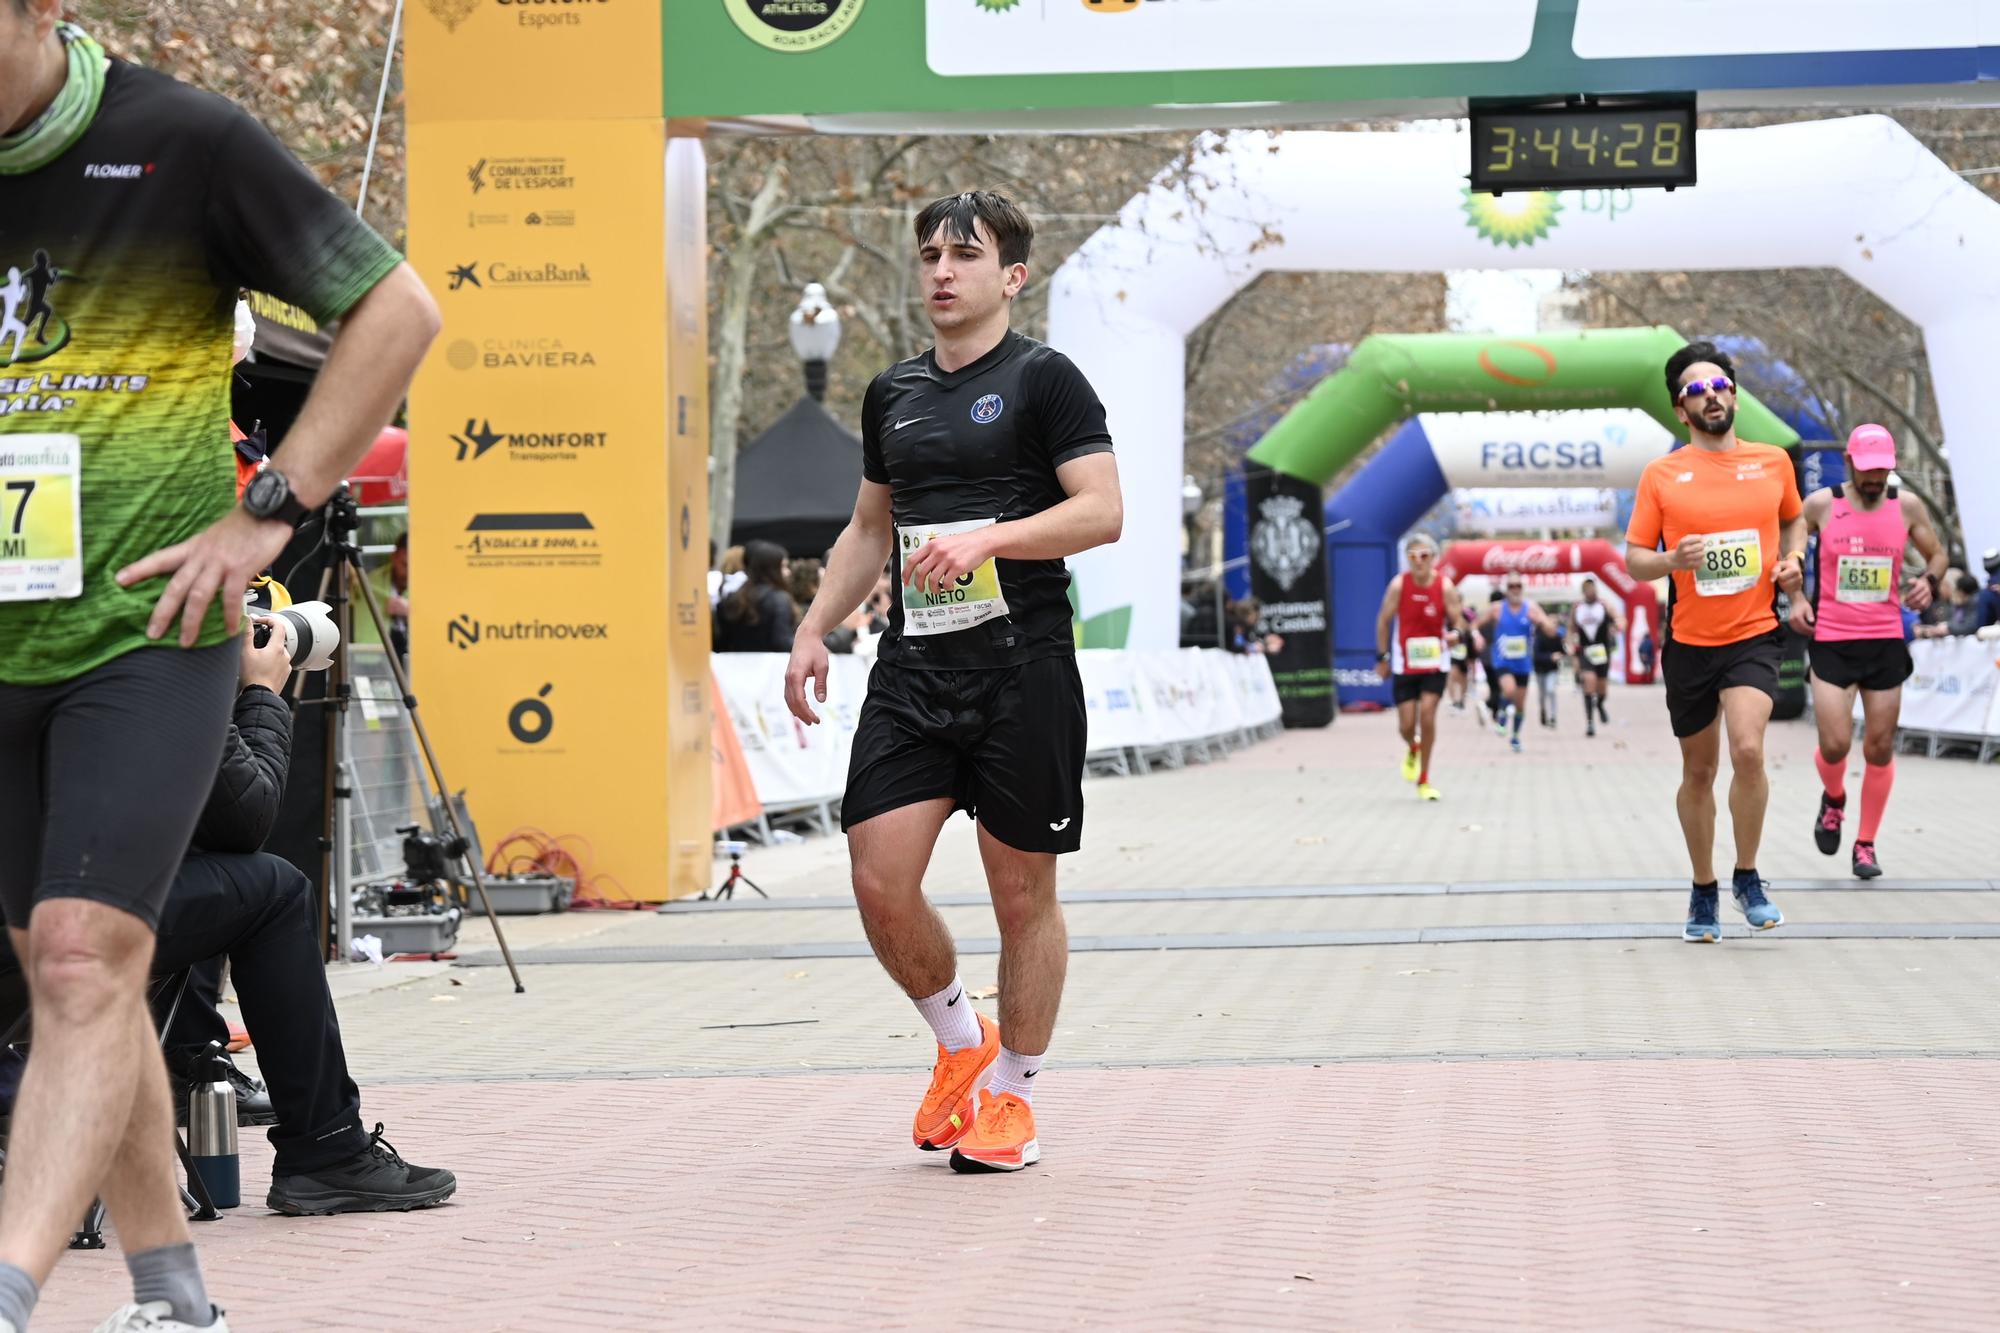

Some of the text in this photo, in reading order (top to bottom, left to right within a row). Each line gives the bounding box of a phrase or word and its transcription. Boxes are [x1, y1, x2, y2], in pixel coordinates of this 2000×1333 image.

[762, 2, 828, 15] ATHLETICS
[518, 10, 580, 30] Esports
[1487, 122, 1682, 171] 3:44:28
[83, 163, 143, 178] FLOWER
[488, 164, 566, 177] COMUNITAT
[488, 261, 592, 283] CaixaBank
[483, 351, 597, 368] BAVIERA
[508, 432, 608, 448] MONFORT
[1705, 547, 1747, 572] 886
[1848, 568, 1879, 584] 651
[925, 588, 966, 606] NIETO
[485, 618, 609, 639] nutrinovex
